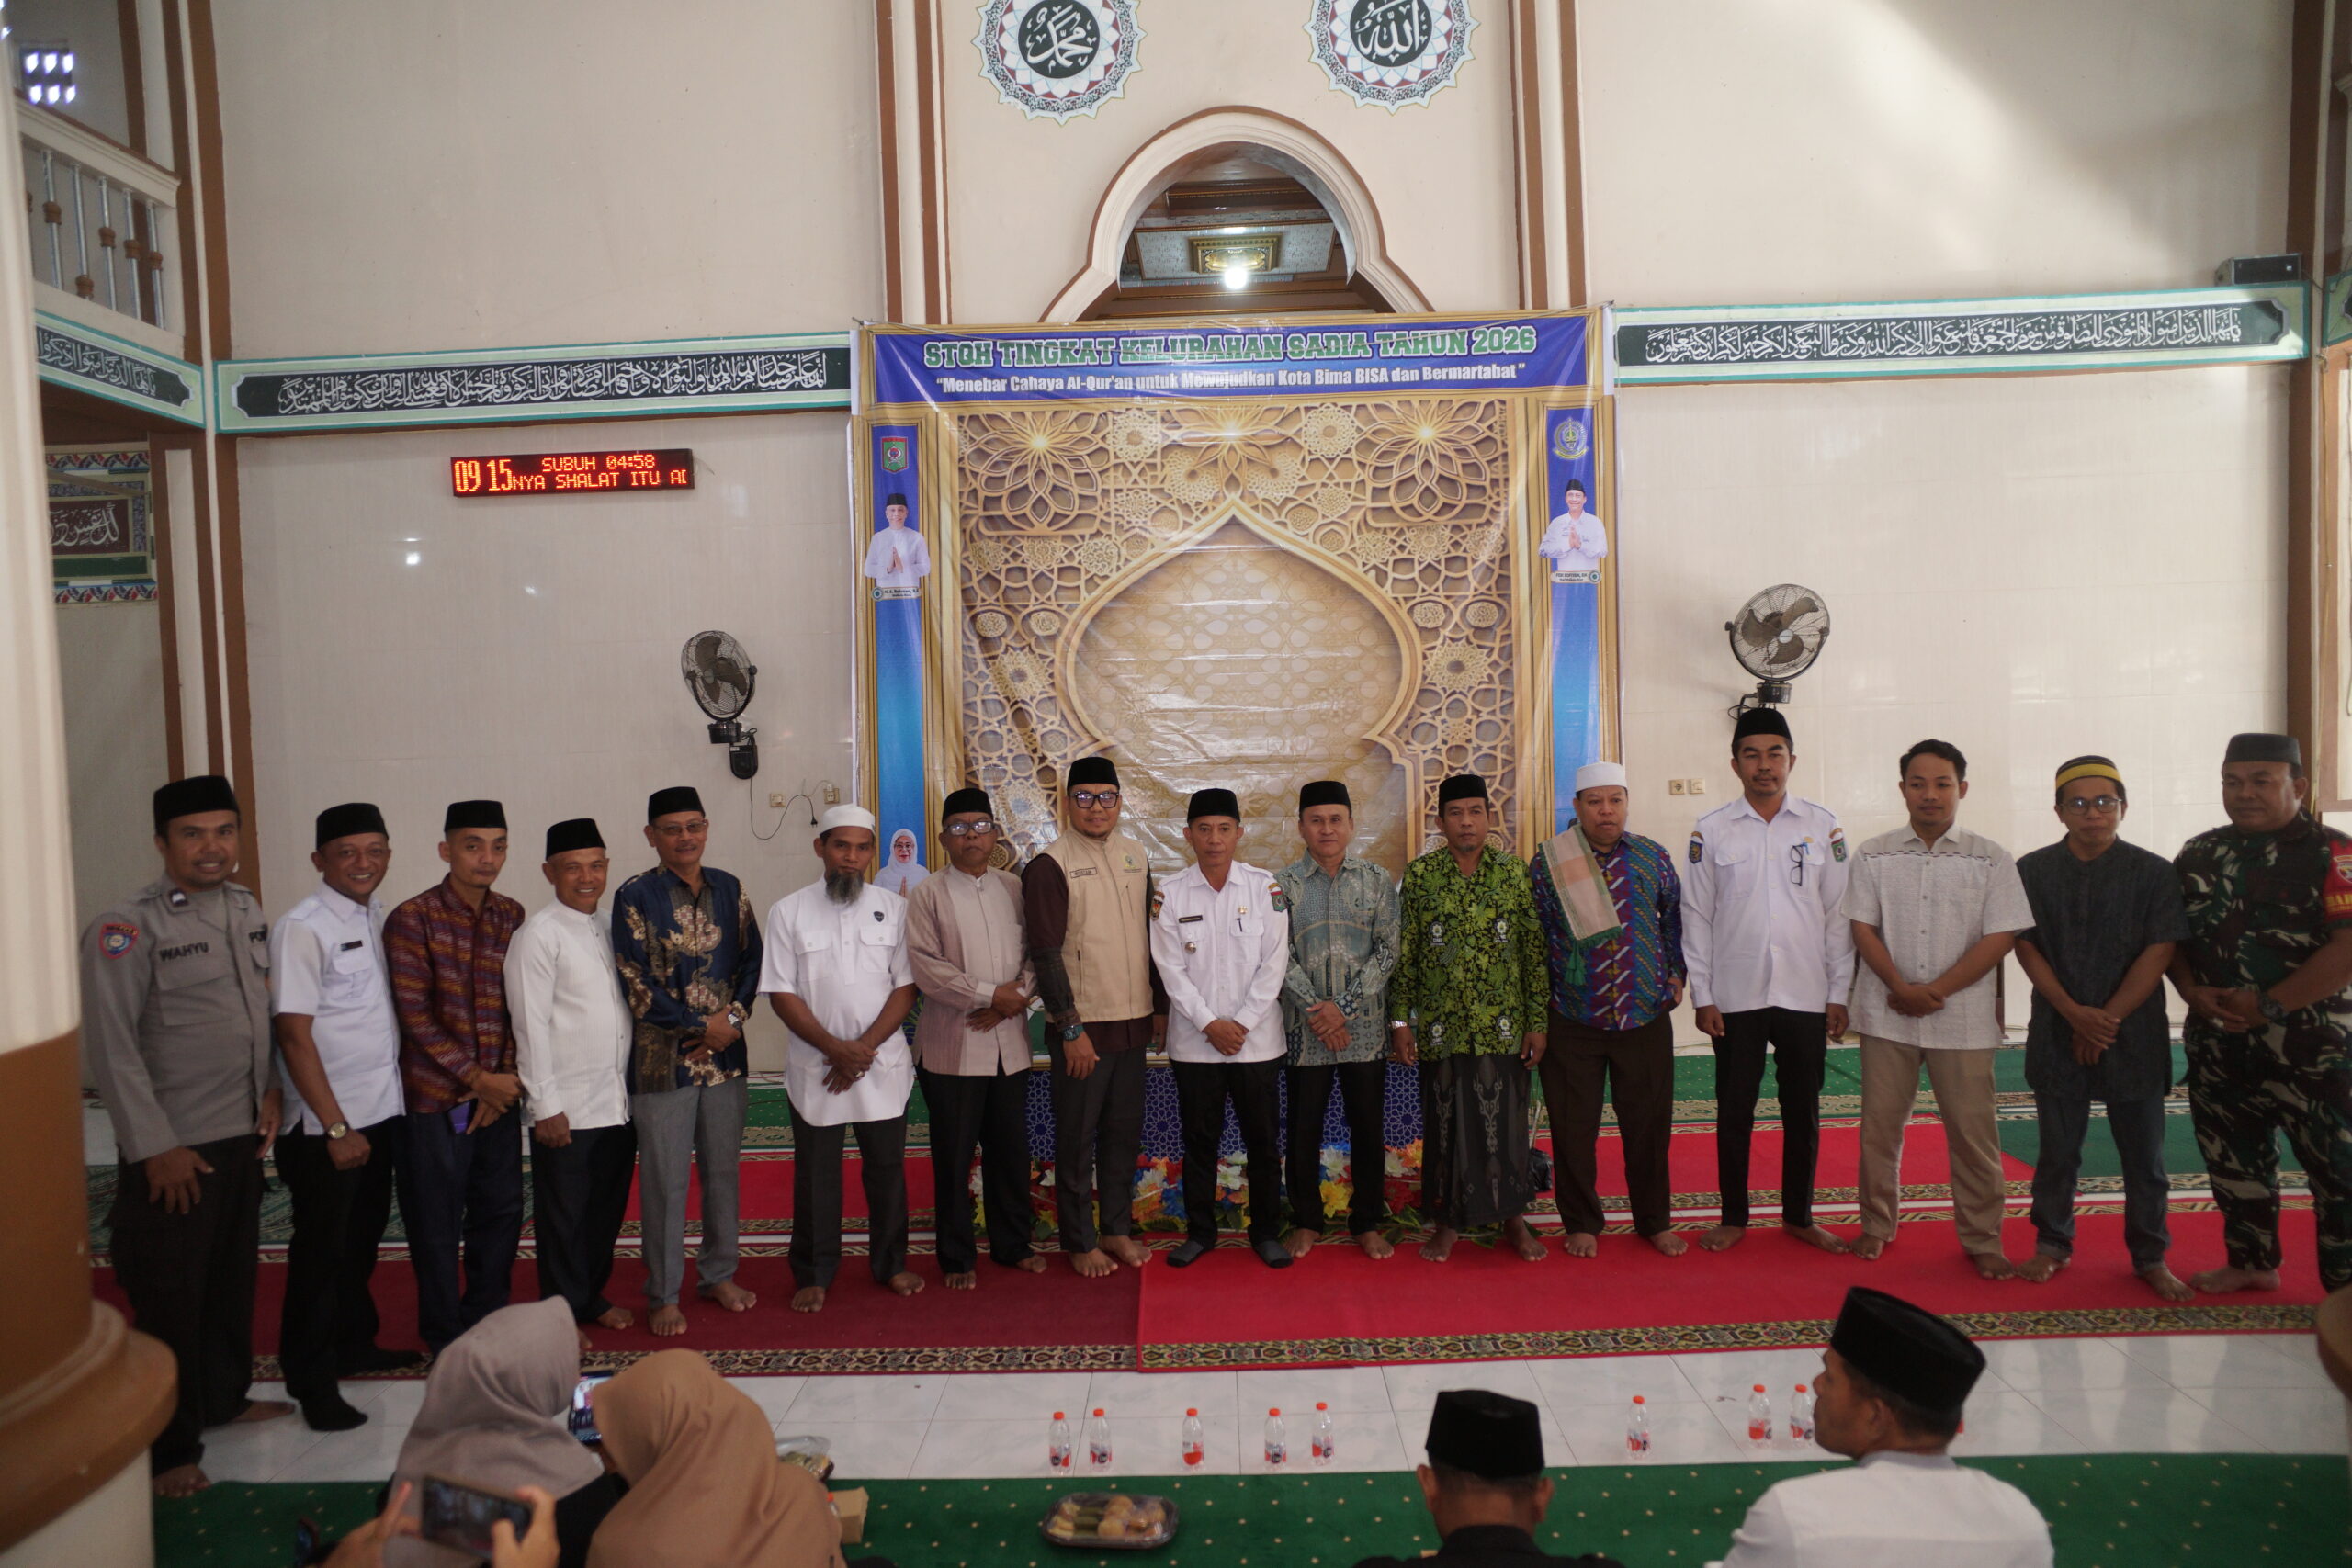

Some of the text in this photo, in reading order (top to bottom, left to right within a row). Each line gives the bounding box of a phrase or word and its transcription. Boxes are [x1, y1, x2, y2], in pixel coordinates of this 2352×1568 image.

[924, 326, 1537, 367] STQH TINGKAT KELURAHAN SADIA TAHUN 2026
[1010, 376, 1064, 392] Cahaya
[1136, 373, 1178, 389] untuk
[1181, 370, 1275, 389] Mewujudkan
[1278, 369, 1311, 386] Kota
[1314, 367, 1351, 385] Bima
[1355, 367, 1389, 384] BISA
[1391, 367, 1419, 382] dan
[541, 454, 655, 472] SUBUH 04:58
[454, 459, 514, 492] 09 15
[513, 475, 546, 490] NYA
[556, 472, 619, 489] SHALAT
[631, 471, 660, 486] ITU
[159, 942, 209, 963] WAHYU
